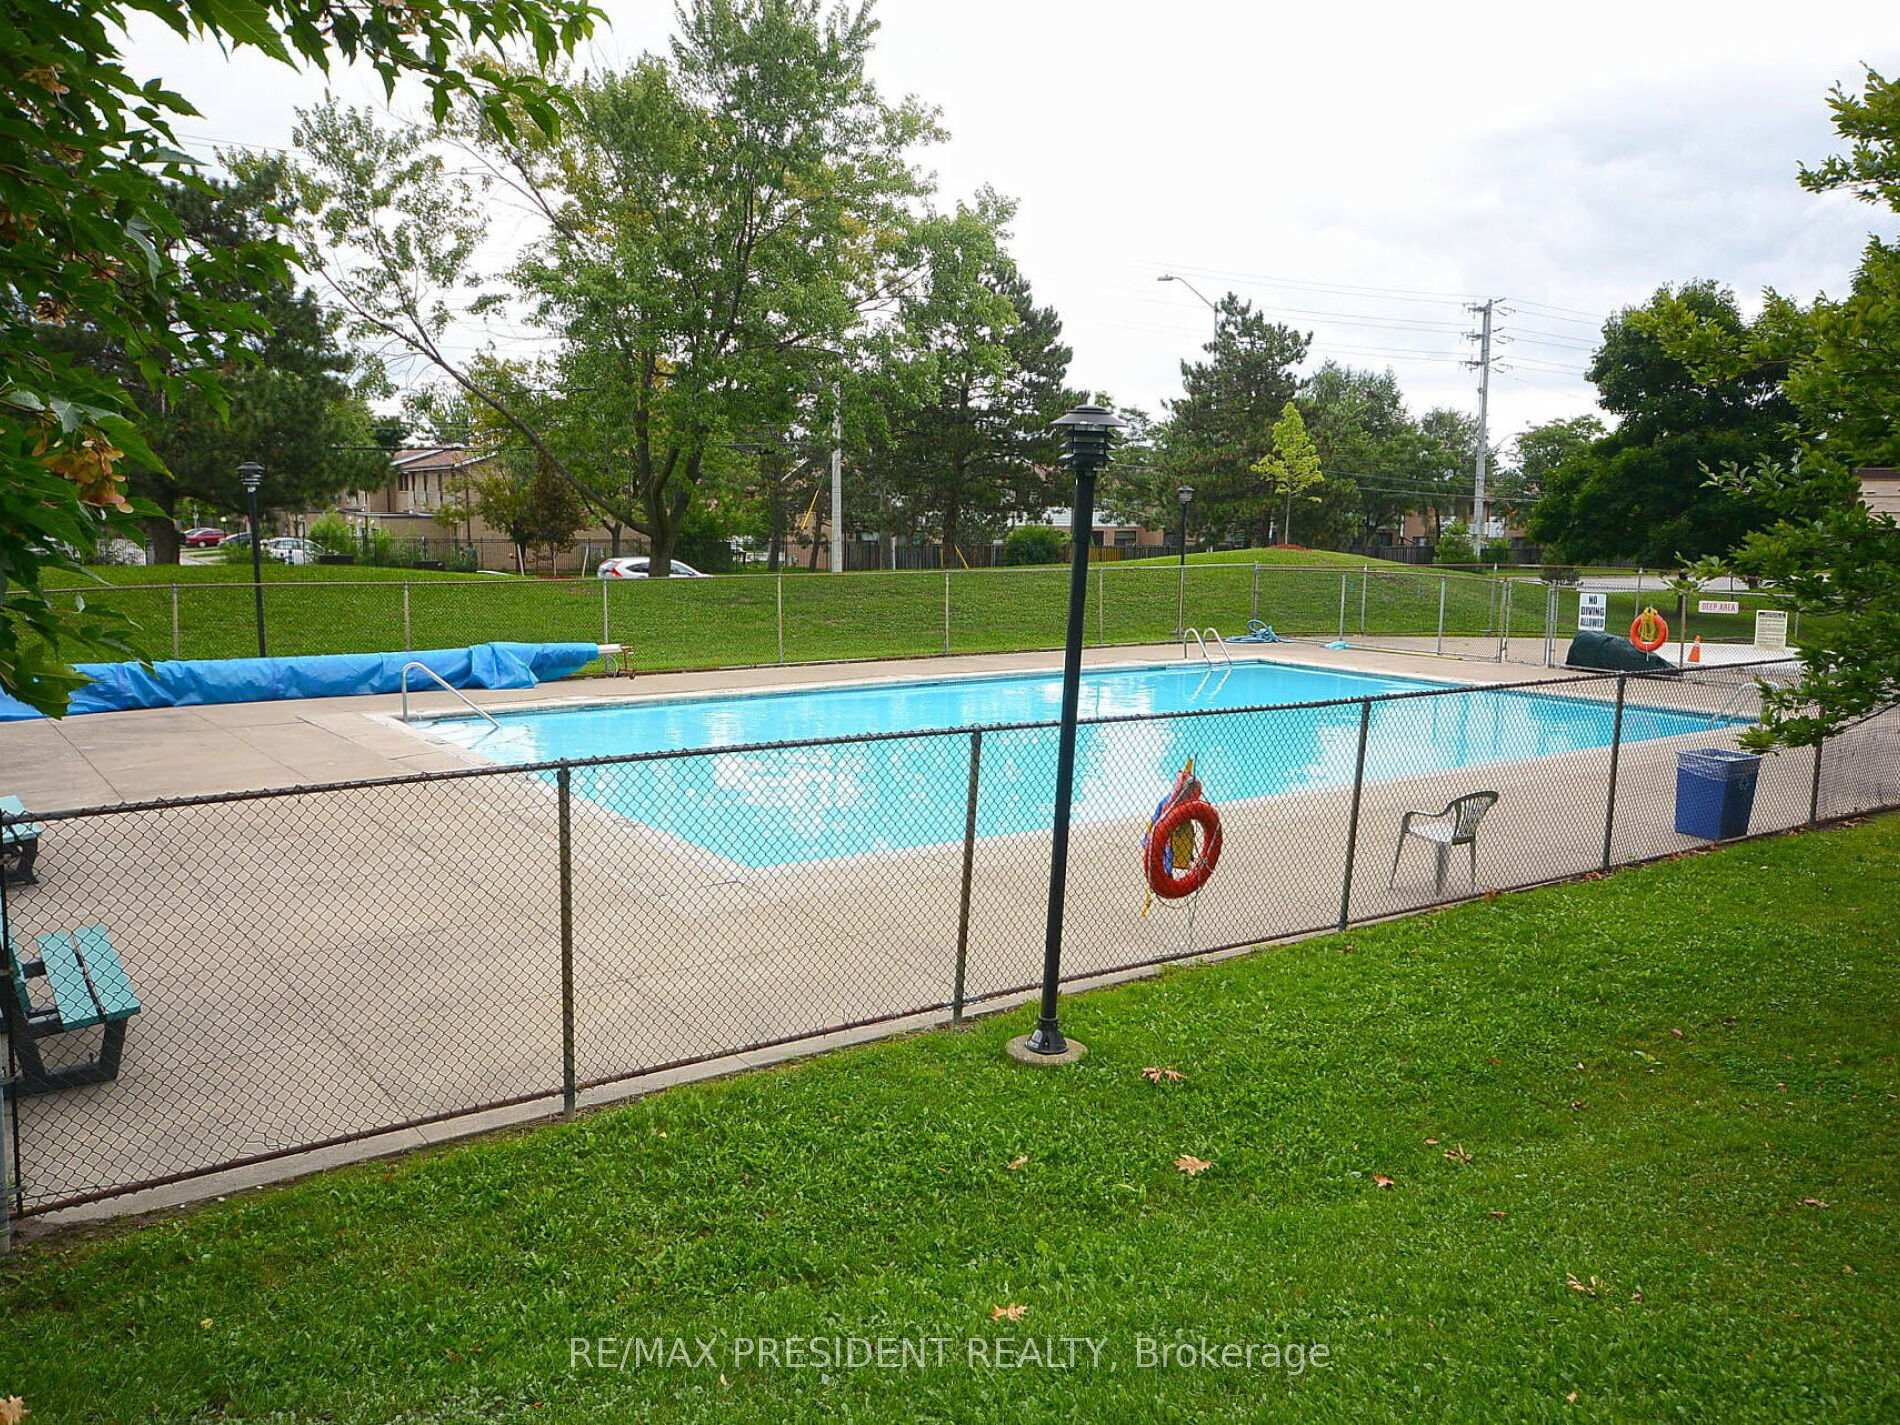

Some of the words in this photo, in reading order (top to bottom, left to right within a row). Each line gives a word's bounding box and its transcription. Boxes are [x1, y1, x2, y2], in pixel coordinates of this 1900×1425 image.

[1588, 595, 1598, 605] NO
[1580, 606, 1605, 616] DIVING
[1701, 602, 1718, 611] DEEP
[1719, 603, 1736, 612] AREA
[1580, 617, 1604, 628] ALLOWED
